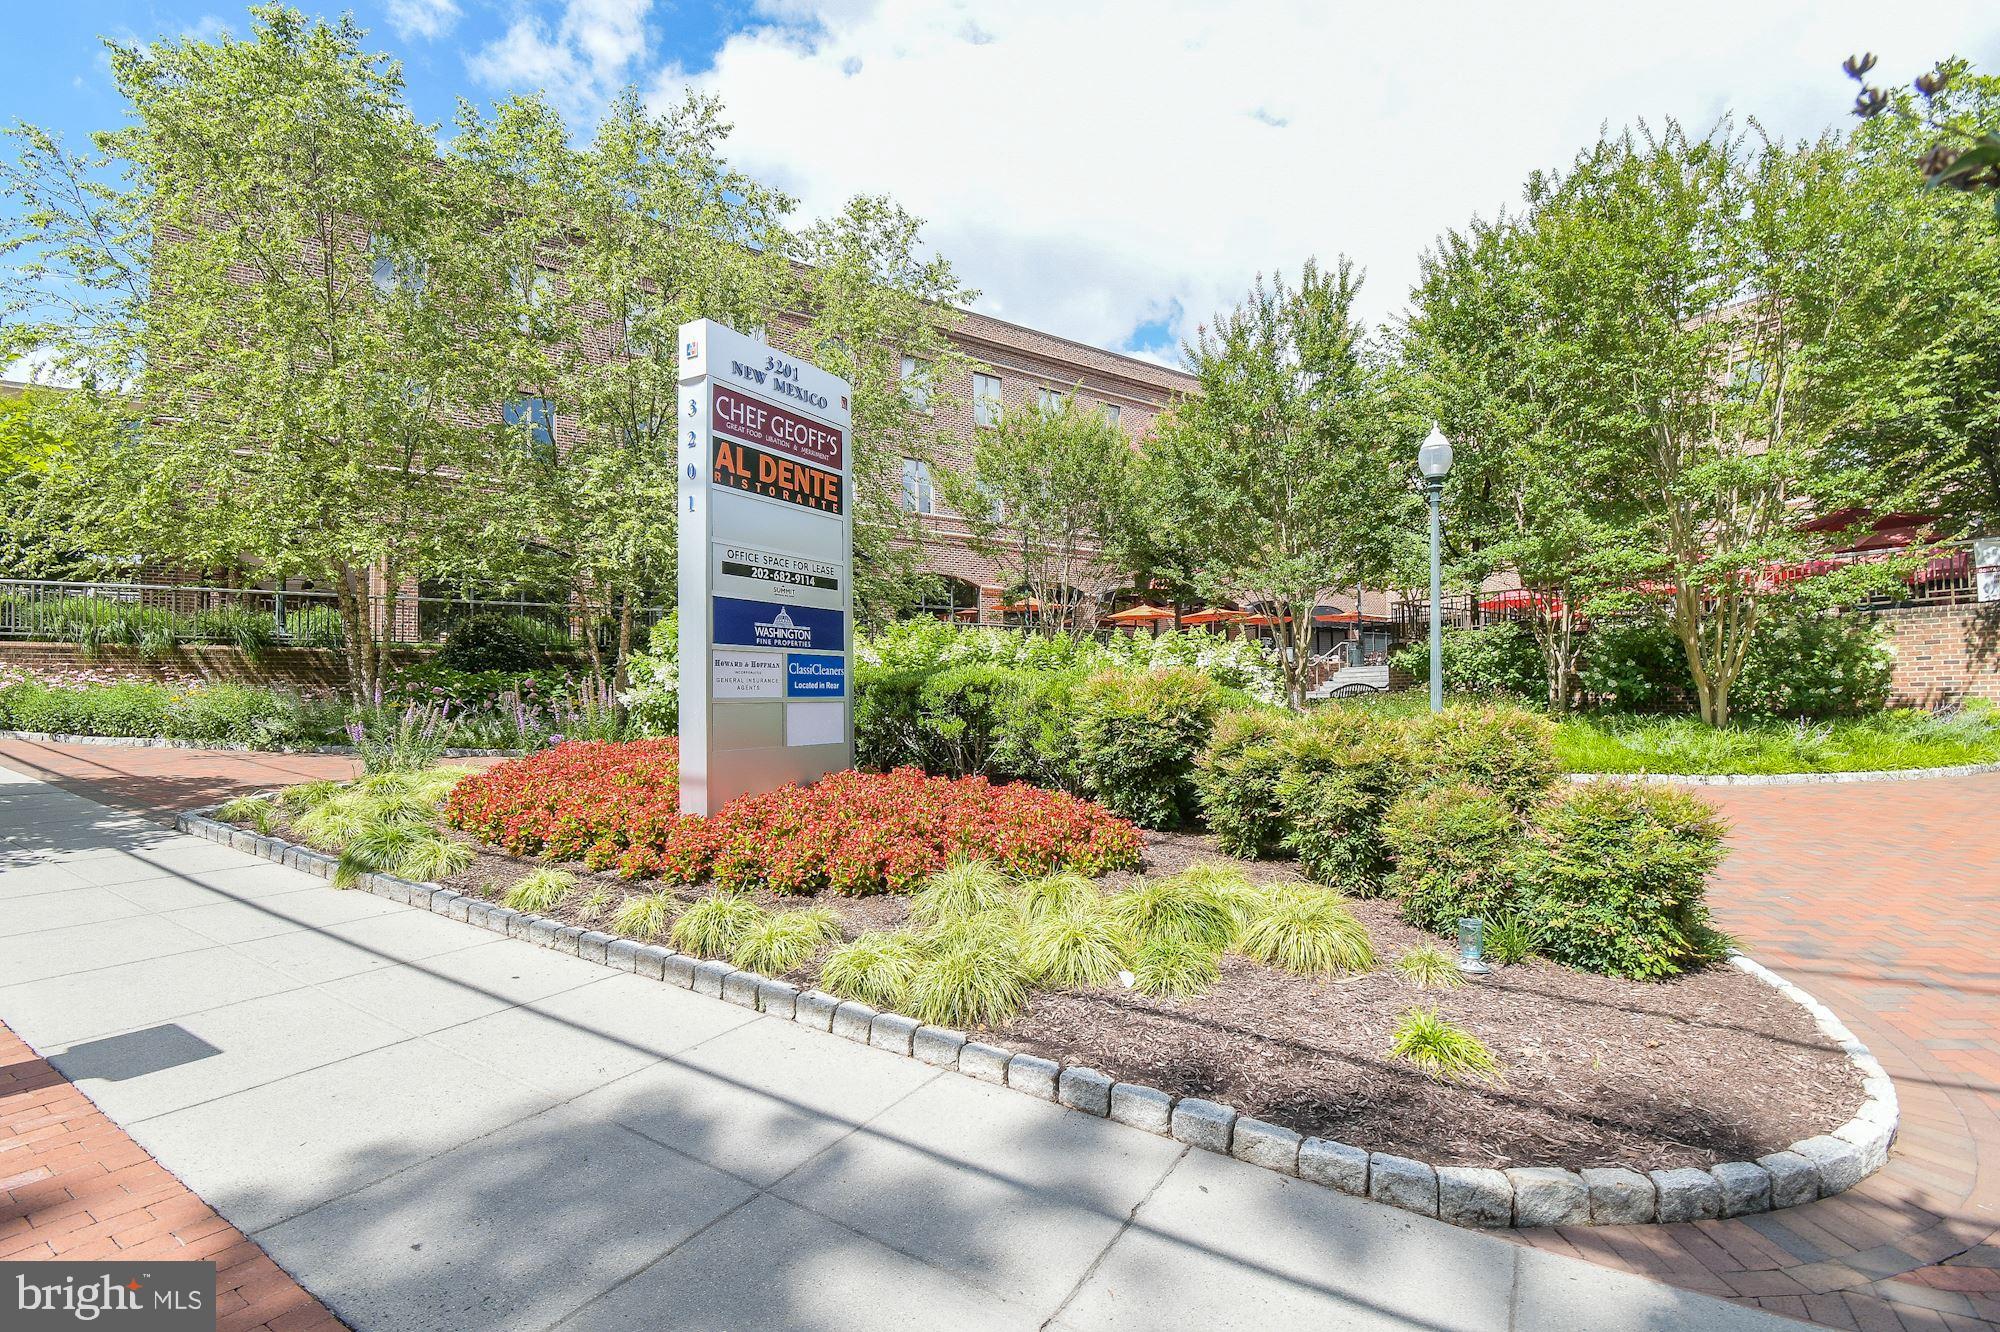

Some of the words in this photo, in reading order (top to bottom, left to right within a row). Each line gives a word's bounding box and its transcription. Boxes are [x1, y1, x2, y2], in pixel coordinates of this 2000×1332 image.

[765, 355, 799, 382] 3201
[731, 360, 767, 385] NEW
[773, 377, 828, 409] MEXICO
[716, 395, 767, 430] CHEF
[771, 416, 838, 456] GEOFF'S
[726, 421, 745, 433] GREAT
[746, 427, 763, 439] FOOD
[687, 399, 697, 512] 3201
[715, 441, 752, 479] AL
[759, 454, 838, 503] DENTE
[713, 471, 838, 513] RISTORANTE
[727, 549, 759, 563] OFFICE
[763, 555, 790, 568] SPACE
[793, 561, 809, 572] FOR
[812, 565, 835, 576] LEASE
[751, 566, 816, 587] 202-682-9114
[754, 626, 811, 640] WASHINGTON
[756, 637, 772, 646] FINE
[774, 639, 811, 648] PROPERTIES
[714, 659, 743, 668] HOWARD
[750, 660, 780, 669] HOFFMAN
[788, 662, 845, 676] ClassiCleaners
[794, 681, 819, 689] Located
[826, 682, 840, 690] Rear
